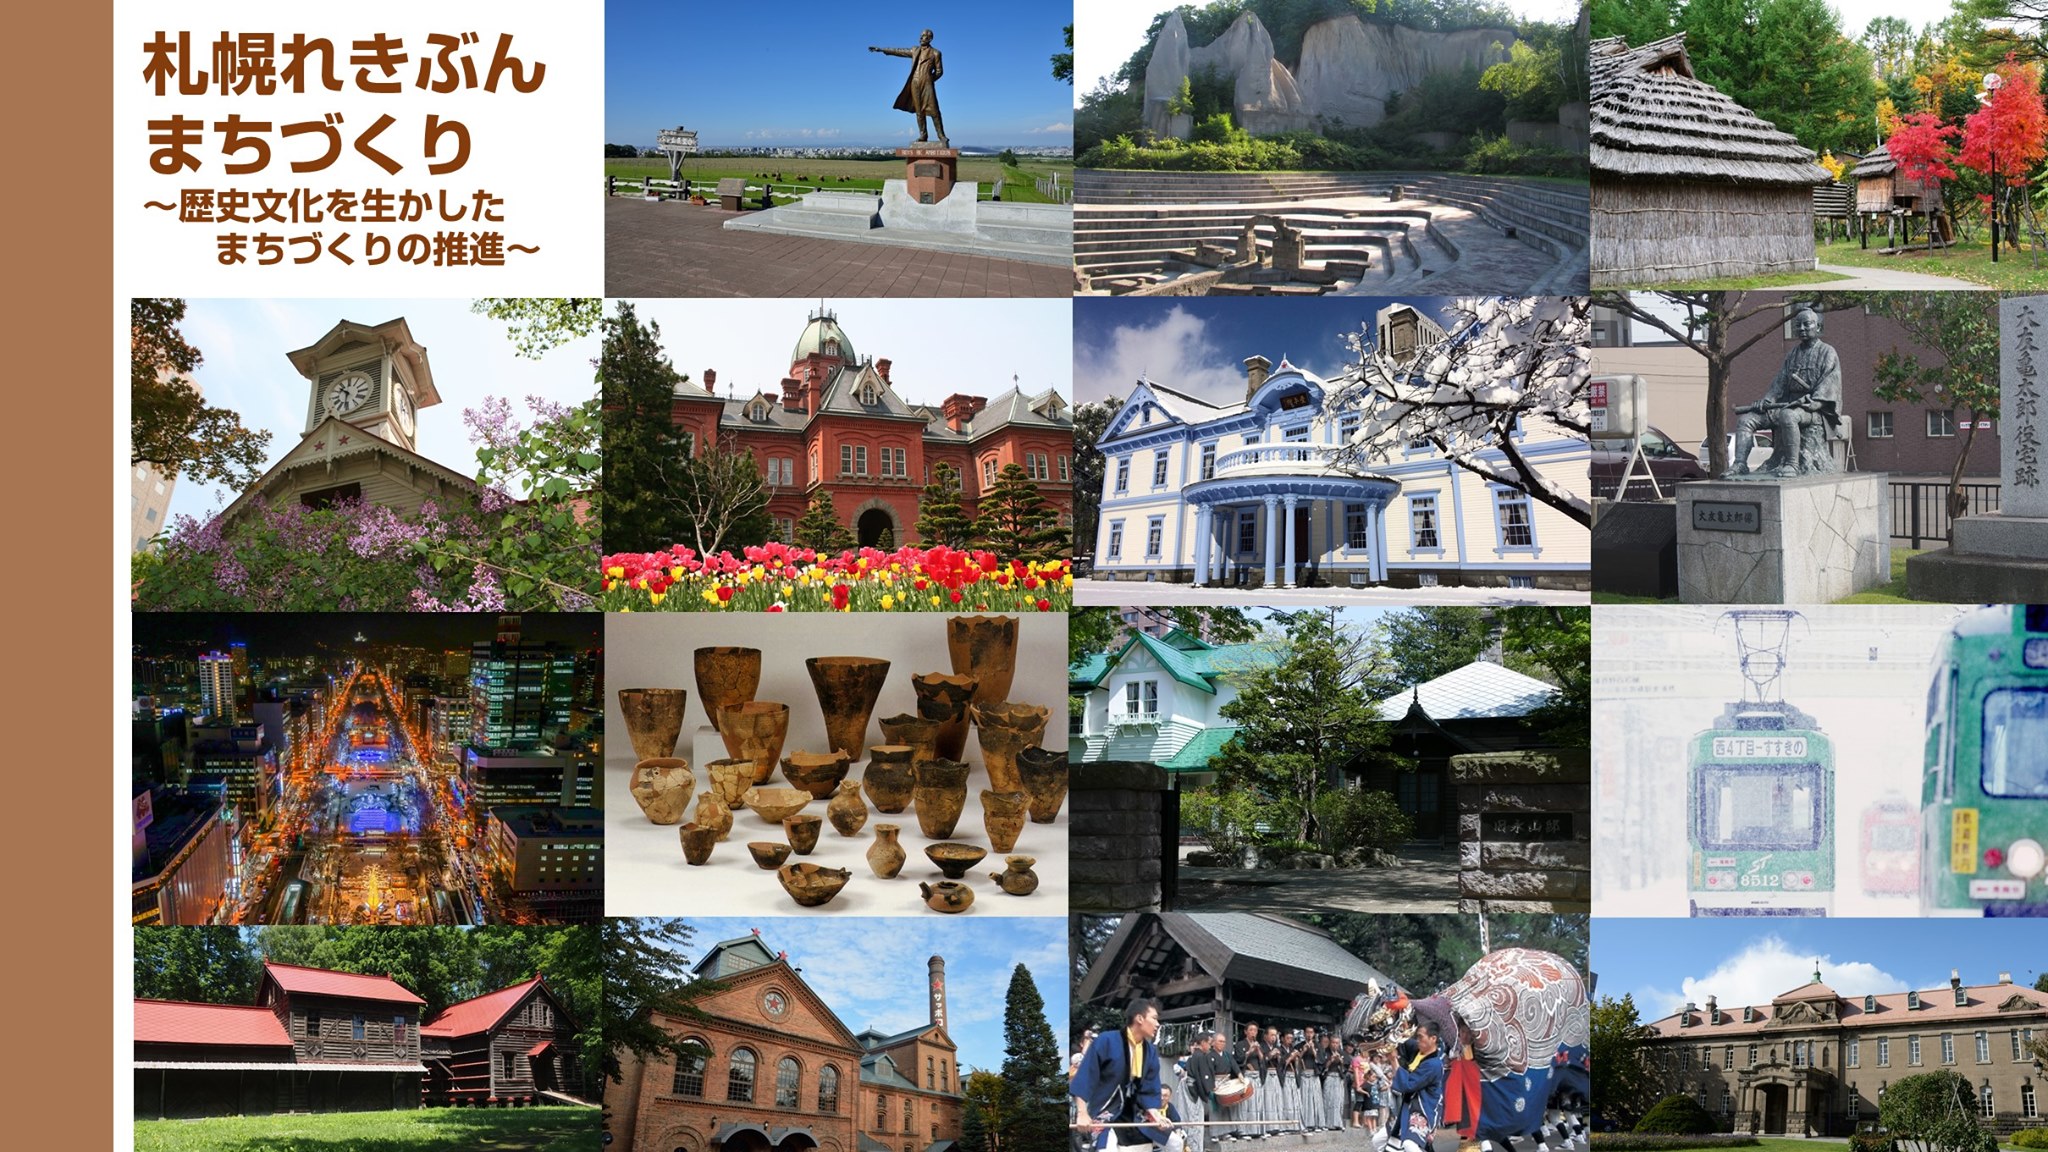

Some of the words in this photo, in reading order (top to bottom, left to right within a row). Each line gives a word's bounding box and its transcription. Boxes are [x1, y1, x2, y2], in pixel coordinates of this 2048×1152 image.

[2014, 304, 2042, 488] 大友亀太郎役宅跡
[1741, 874, 1779, 887] 8512
[933, 993, 944, 1027] サッポロ
